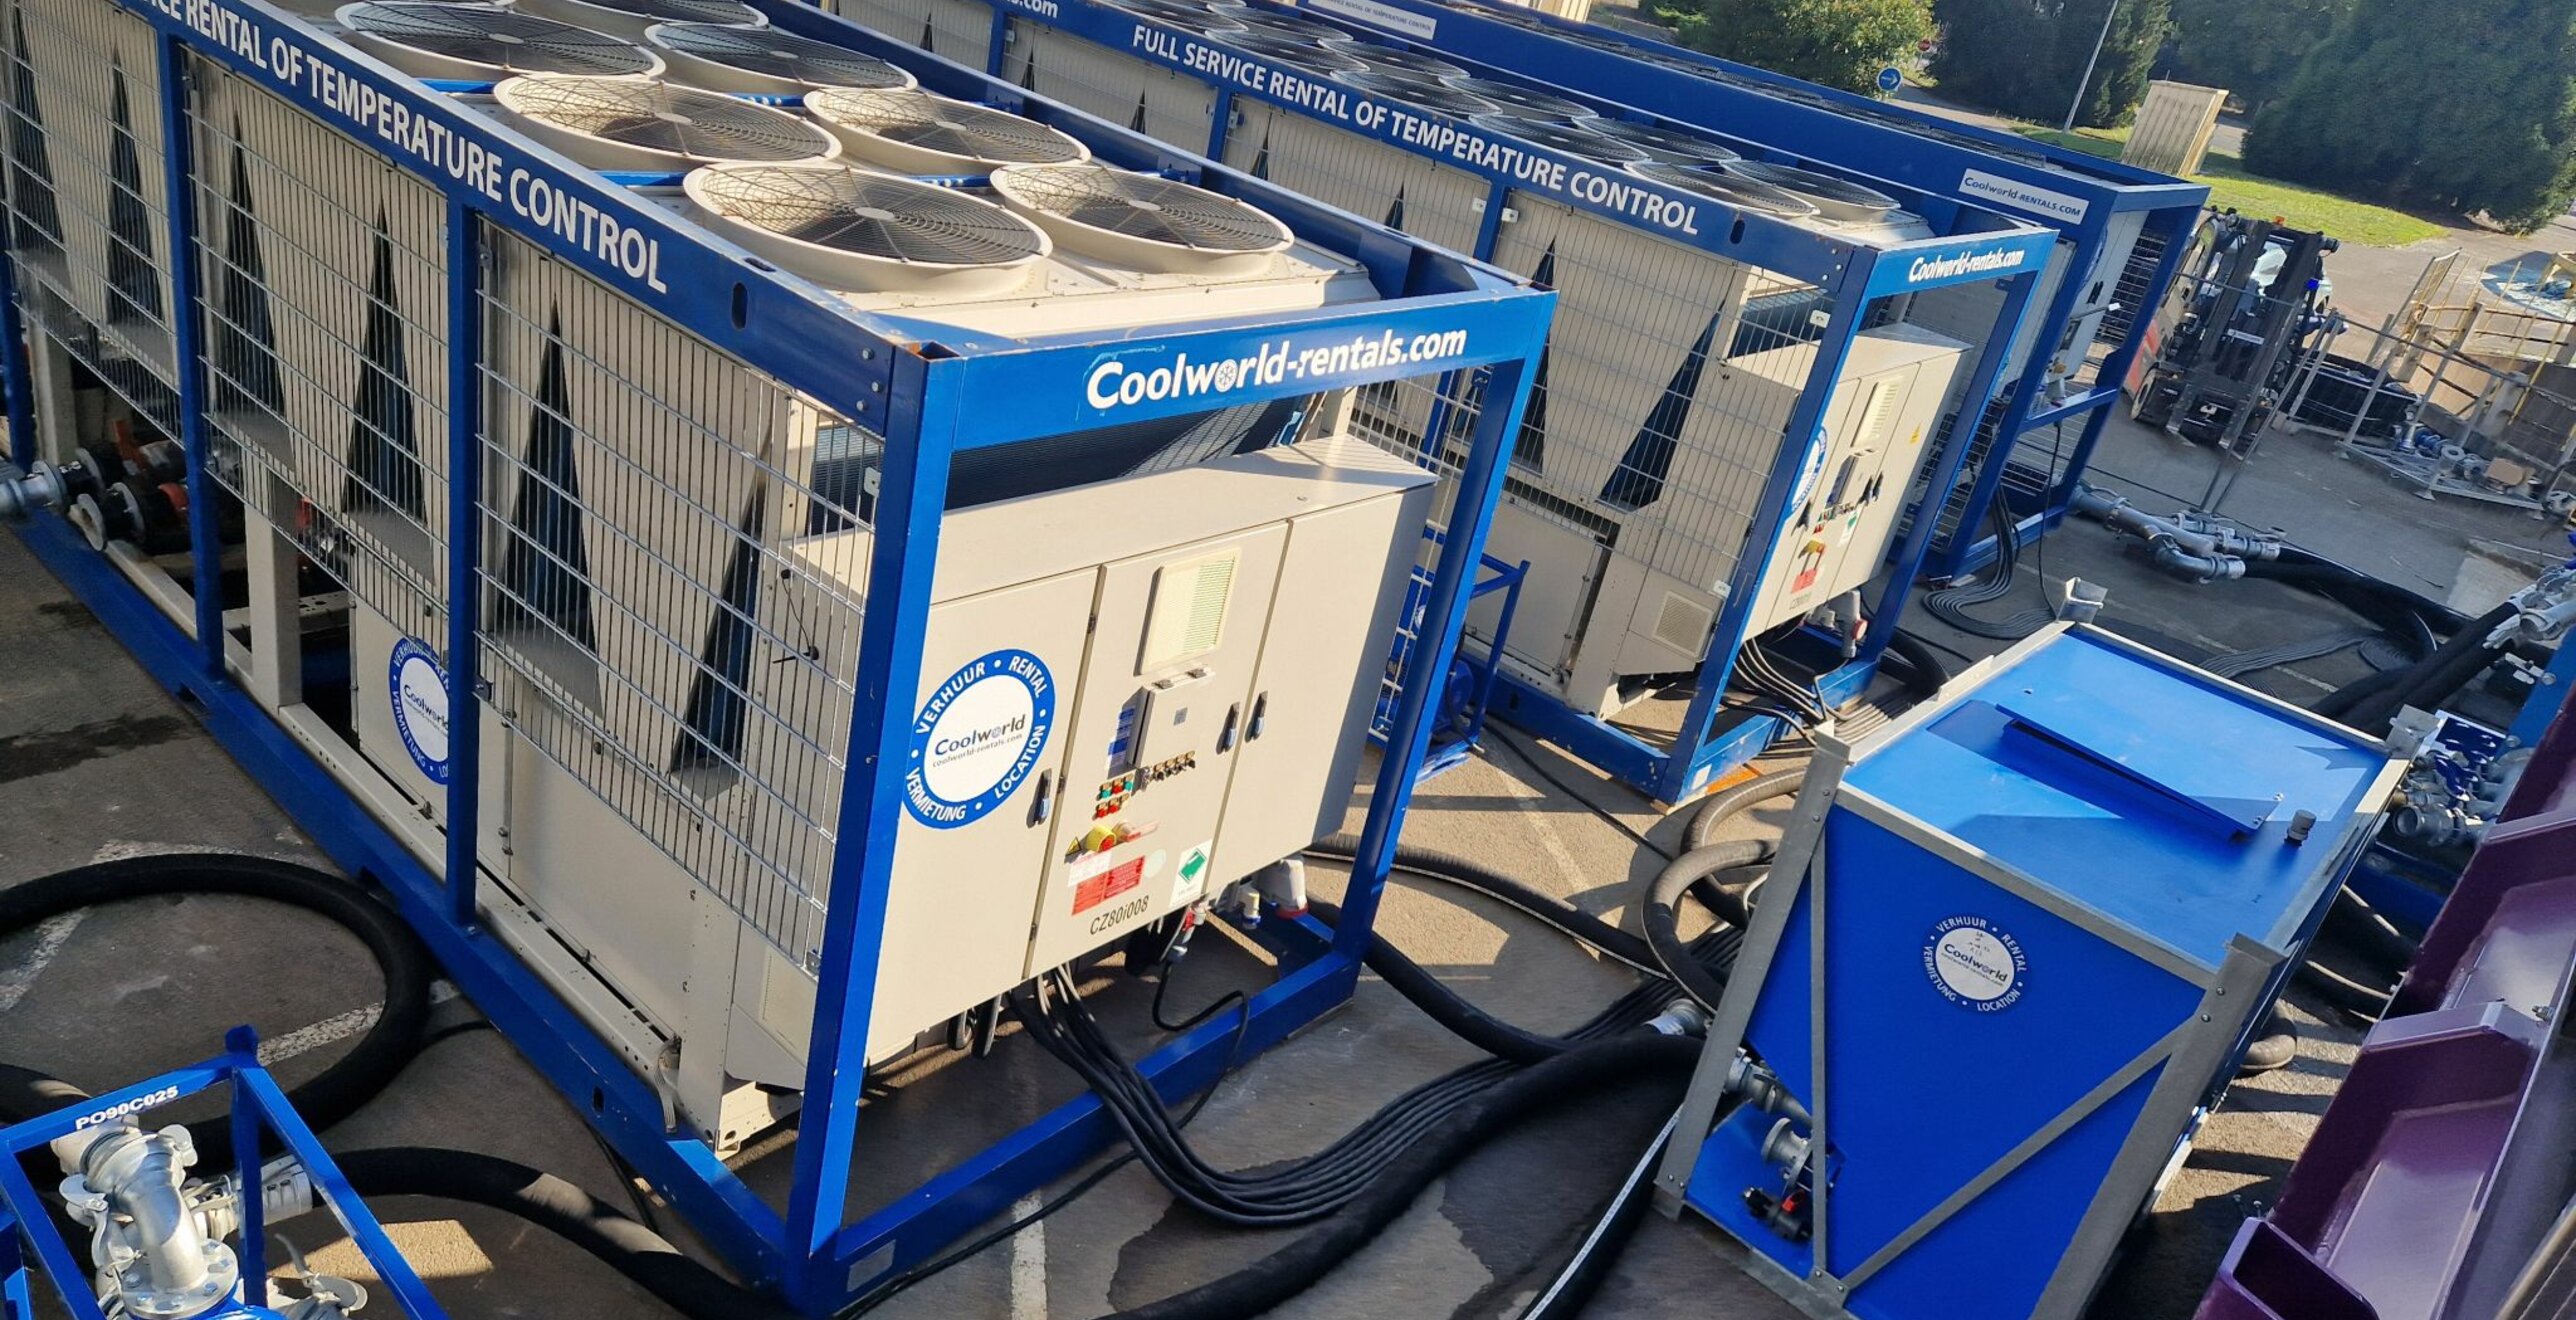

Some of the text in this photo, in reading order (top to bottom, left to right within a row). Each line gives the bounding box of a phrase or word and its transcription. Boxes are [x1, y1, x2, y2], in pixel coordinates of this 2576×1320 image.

[186, 0, 668, 294] RENTAL OF TEMPERATURE CONTROL
[1132, 25, 1699, 235] FULL SERVICE RENTAL OF TEMPERATURE CONTROL
[1908, 247, 2025, 283] Coolworld-rentals.com
[1087, 329, 1467, 409] Coolworld-rentals.com
[916, 662, 985, 735] VERHUUR
[1008, 655, 1047, 698] RENTAL
[934, 714, 1026, 756] Coolworld
[994, 724, 1046, 799] LOCATION
[906, 767, 967, 822] VERMIETUNG
[1089, 895, 1149, 936] CZ80i008
[1936, 916, 1987, 933] VERHUUR
[1923, 946, 1957, 1002] VERMIETUNG
[1944, 943, 2008, 982] Coolworld
[2001, 933, 2027, 972] RENTAL
[1976, 988, 2021, 1012] LOCATION
[75, 1085, 178, 1130] PO90C025
